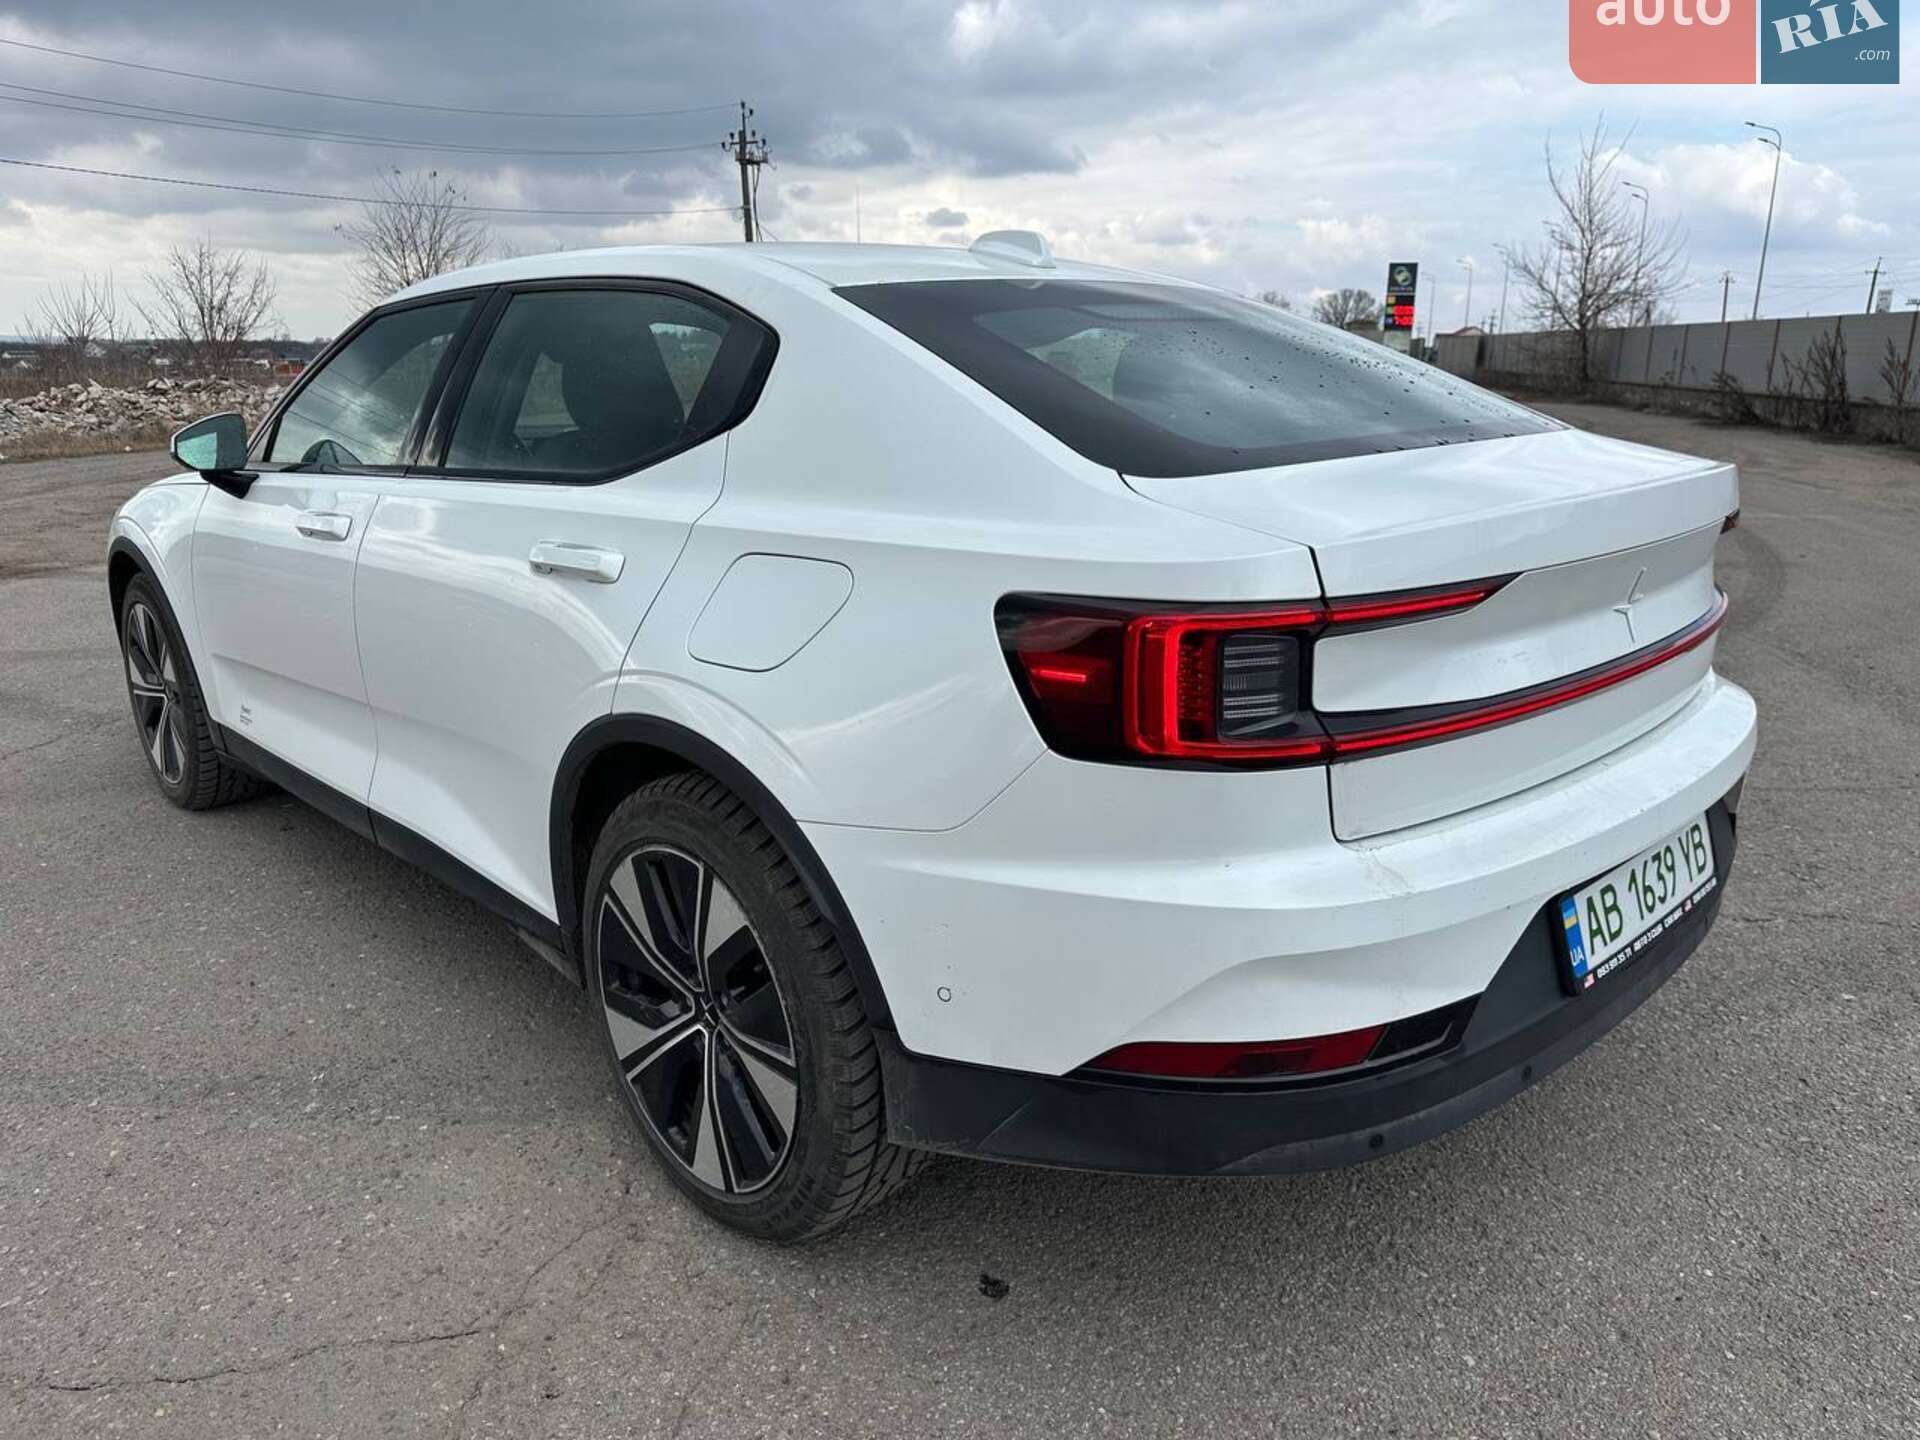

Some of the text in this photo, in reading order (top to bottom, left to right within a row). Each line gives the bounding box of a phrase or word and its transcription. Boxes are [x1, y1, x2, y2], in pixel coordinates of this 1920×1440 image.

[1586, 824, 1707, 956] AB 1639 YB
[1570, 945, 1585, 967] UA
